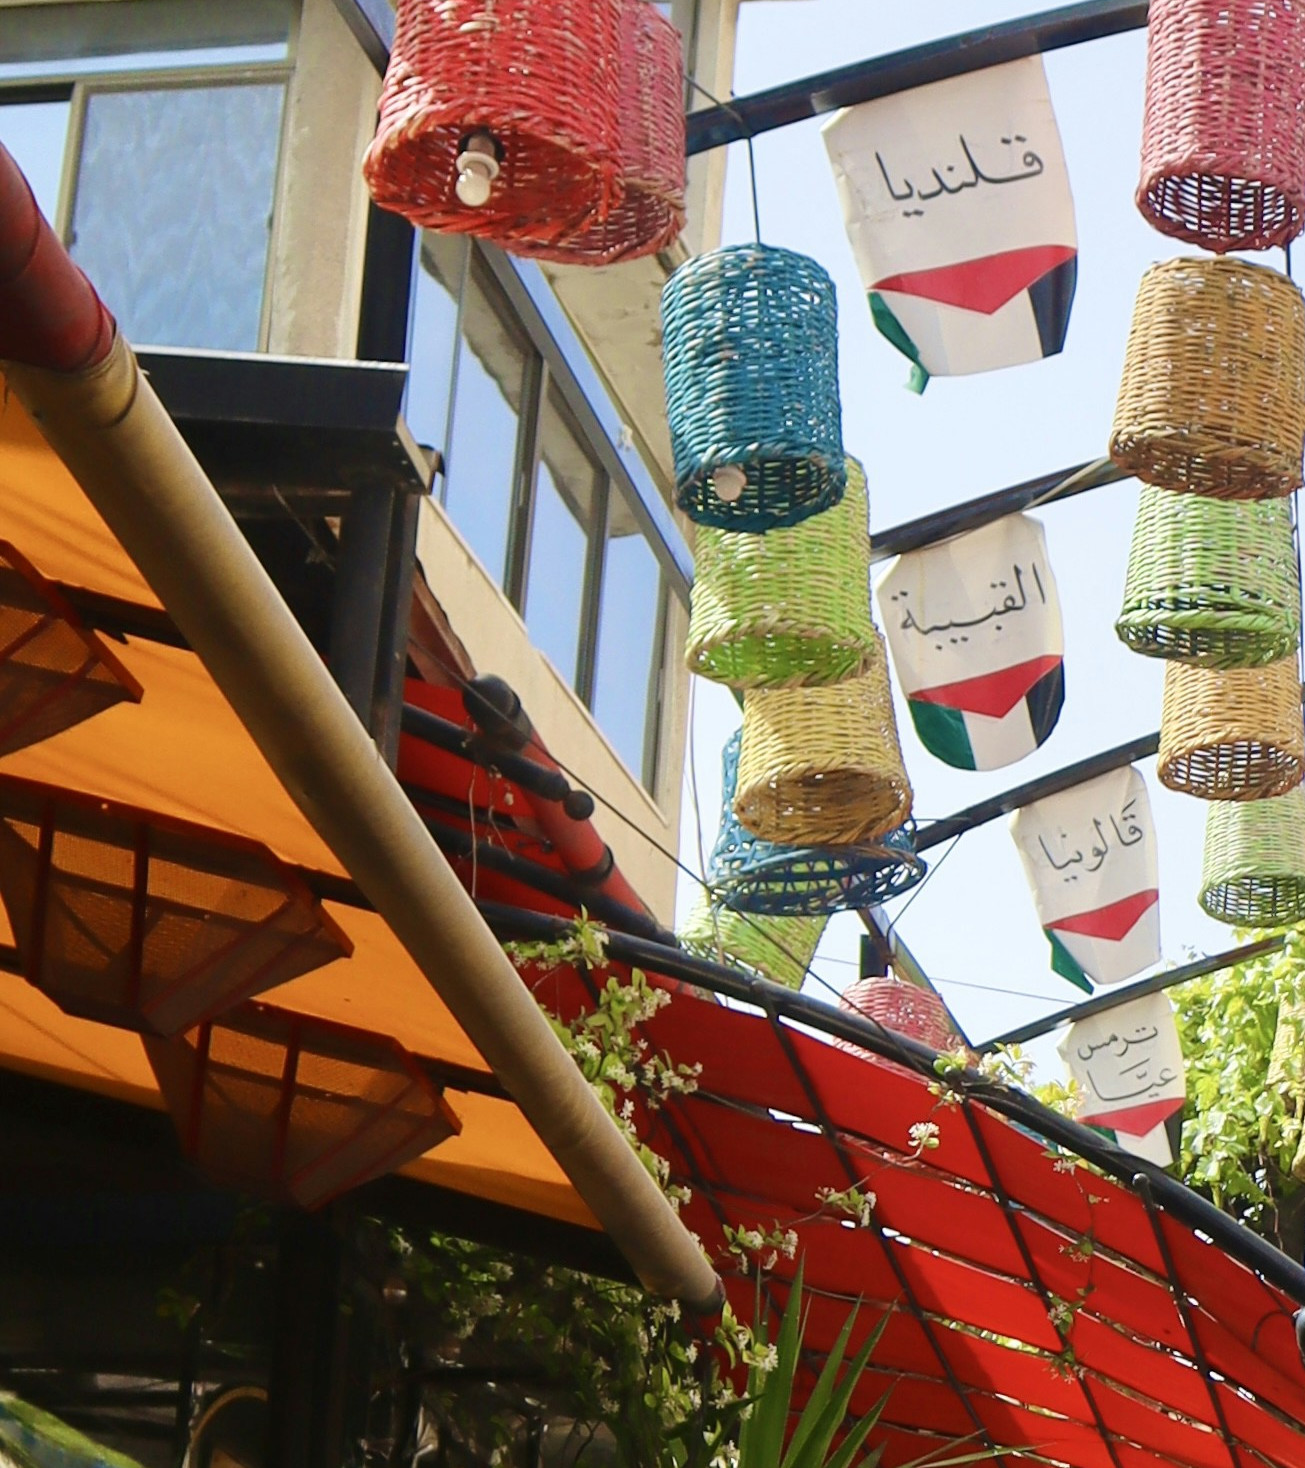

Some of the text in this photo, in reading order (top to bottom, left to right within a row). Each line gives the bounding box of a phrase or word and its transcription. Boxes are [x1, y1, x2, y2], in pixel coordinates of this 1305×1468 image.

[874, 134, 1046, 219] قلنديا
[890, 561, 1047, 653] القبيبة
[1077, 1026, 1159, 1061] ترمس
